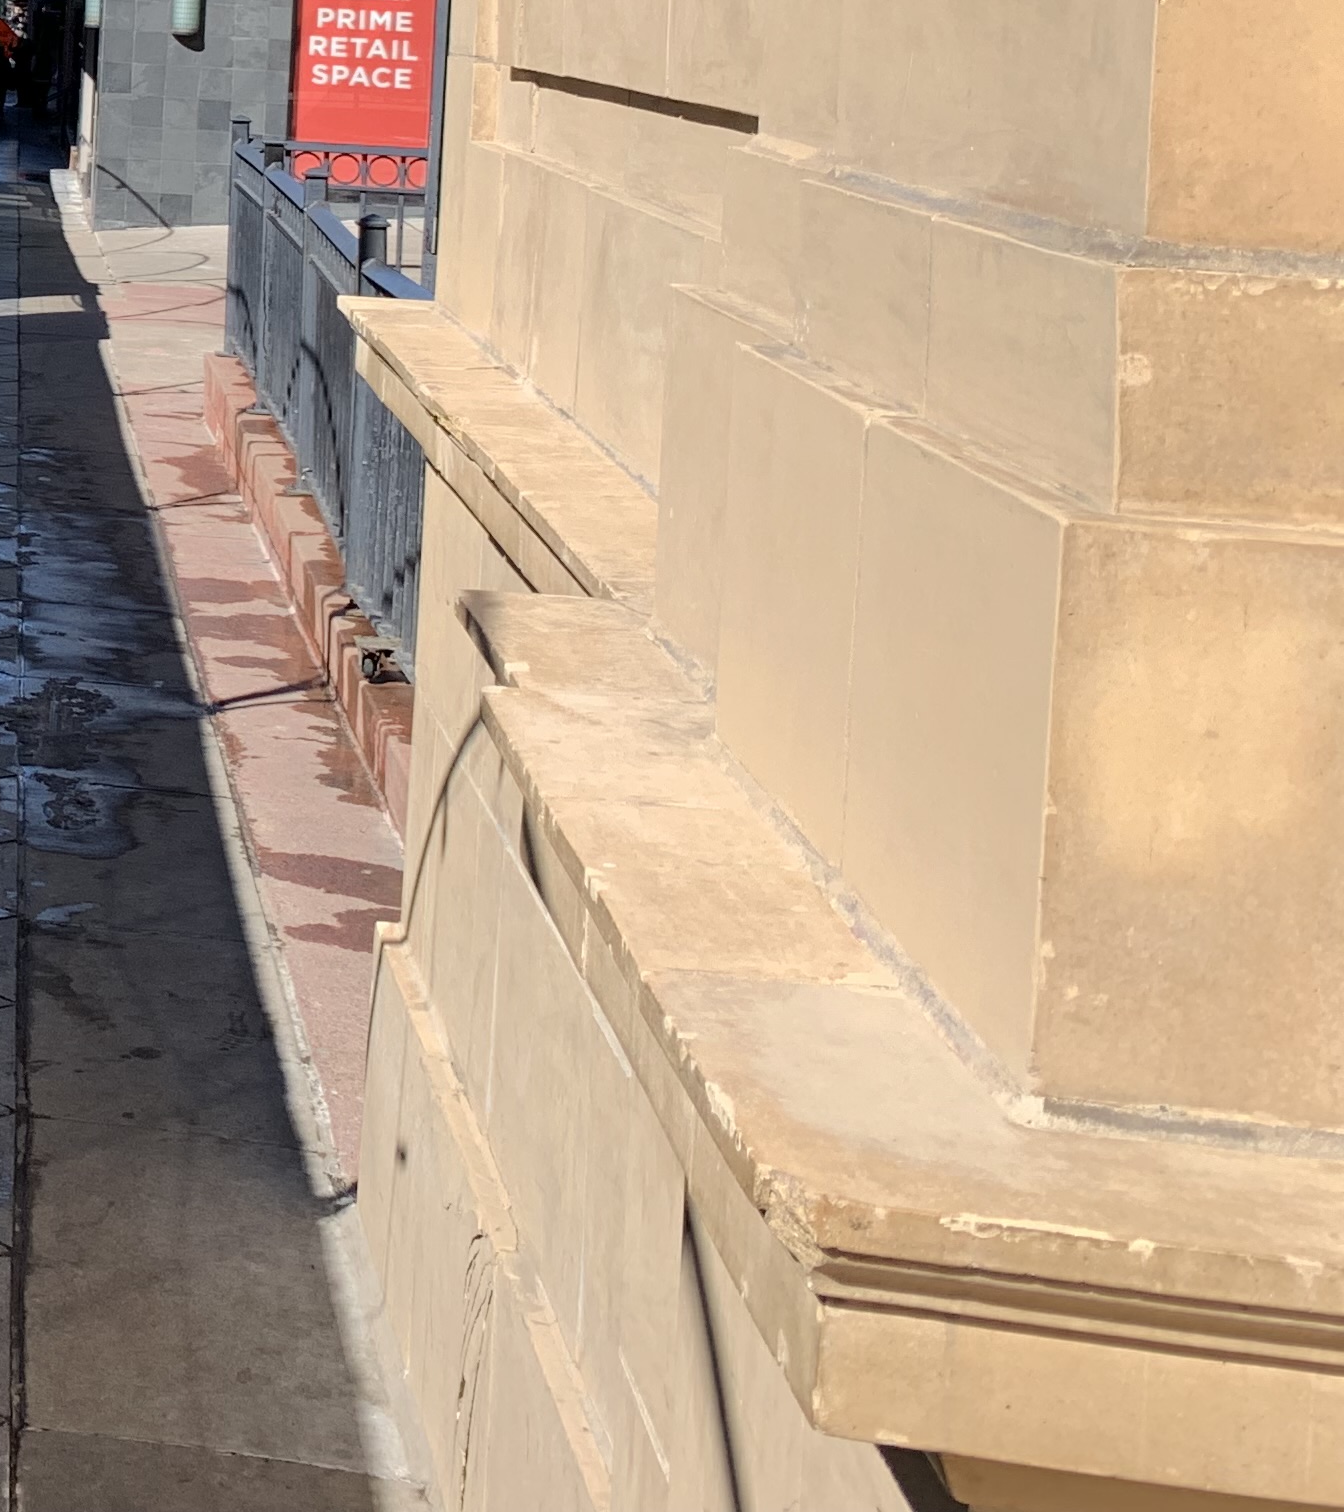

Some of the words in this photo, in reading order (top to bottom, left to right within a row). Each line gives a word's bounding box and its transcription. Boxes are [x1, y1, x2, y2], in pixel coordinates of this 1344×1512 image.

[317, 8, 413, 33] PRIME
[309, 35, 418, 61] RETAIL
[312, 64, 412, 90] SPACE
